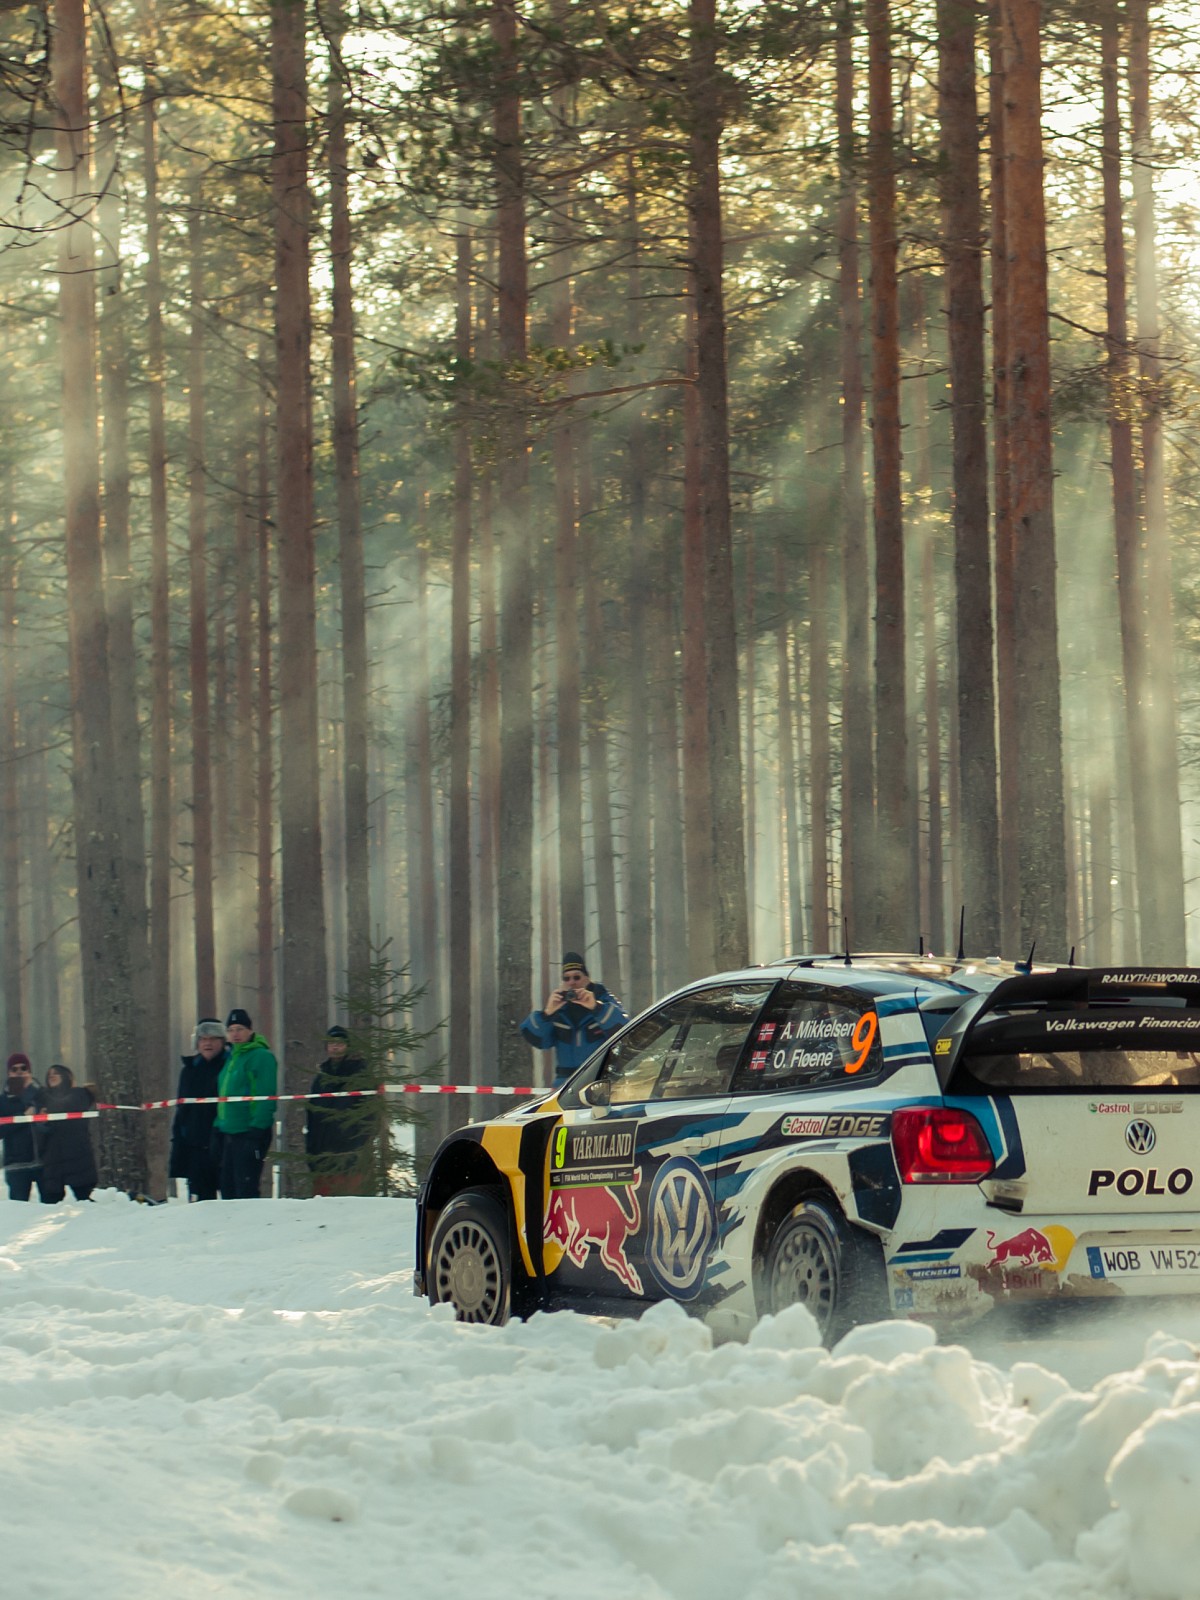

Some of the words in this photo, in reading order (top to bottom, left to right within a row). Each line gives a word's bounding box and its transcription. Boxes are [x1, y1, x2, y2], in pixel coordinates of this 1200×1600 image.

[780, 1022, 792, 1040] A.
[796, 1020, 856, 1039] Mikkelsen
[1045, 1018, 1135, 1032] Volkswagen
[844, 1011, 878, 1074] 9
[773, 1050, 786, 1069] O.
[790, 1051, 834, 1068] Fløene
[1098, 1103, 1130, 1114] Castrol
[1133, 1101, 1184, 1115] EDGE
[790, 1117, 825, 1134] Castrol
[824, 1116, 885, 1136] EDGE
[555, 1127, 567, 1169] 9
[572, 1131, 632, 1160] VÄRMLAND
[1088, 1167, 1194, 1197] POLO
[1094, 1265, 1101, 1274] D
[1103, 1250, 1141, 1272] WOB
[912, 1266, 960, 1278] MICHELIN
